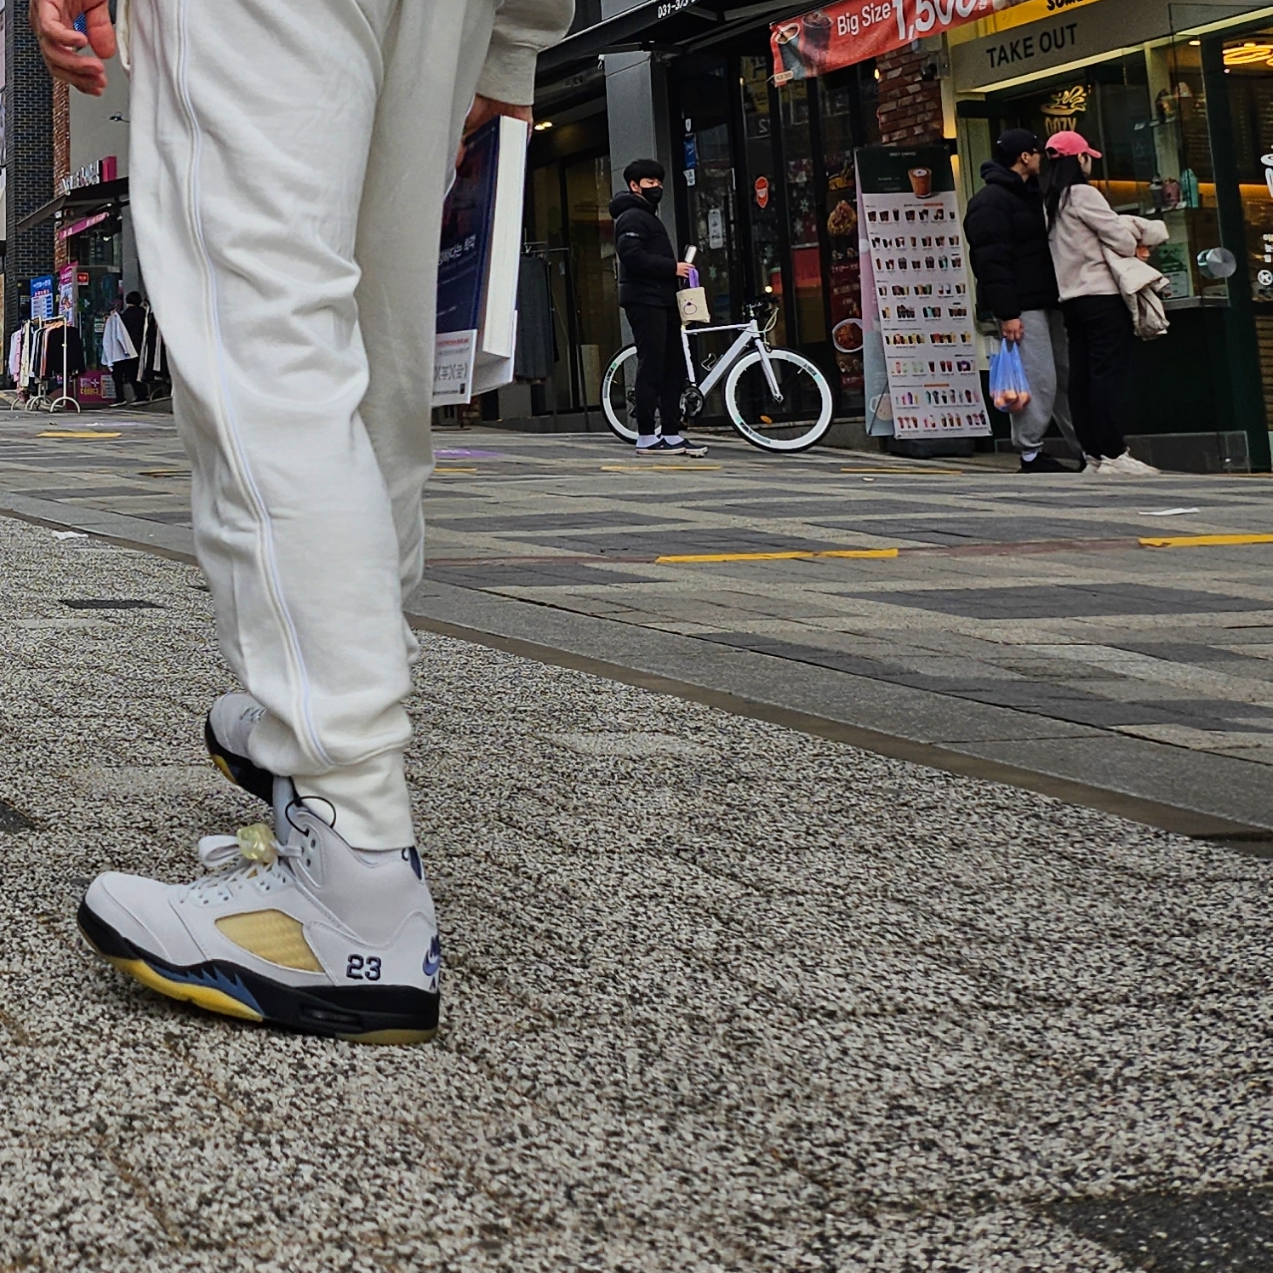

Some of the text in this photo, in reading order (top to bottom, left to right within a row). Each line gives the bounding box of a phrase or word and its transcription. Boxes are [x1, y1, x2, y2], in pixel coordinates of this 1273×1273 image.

[836, 12, 859, 37] Big
[861, 0, 892, 28] Size
[986, 24, 1078, 68] TAKE OUT
[345, 953, 383, 982] 23
